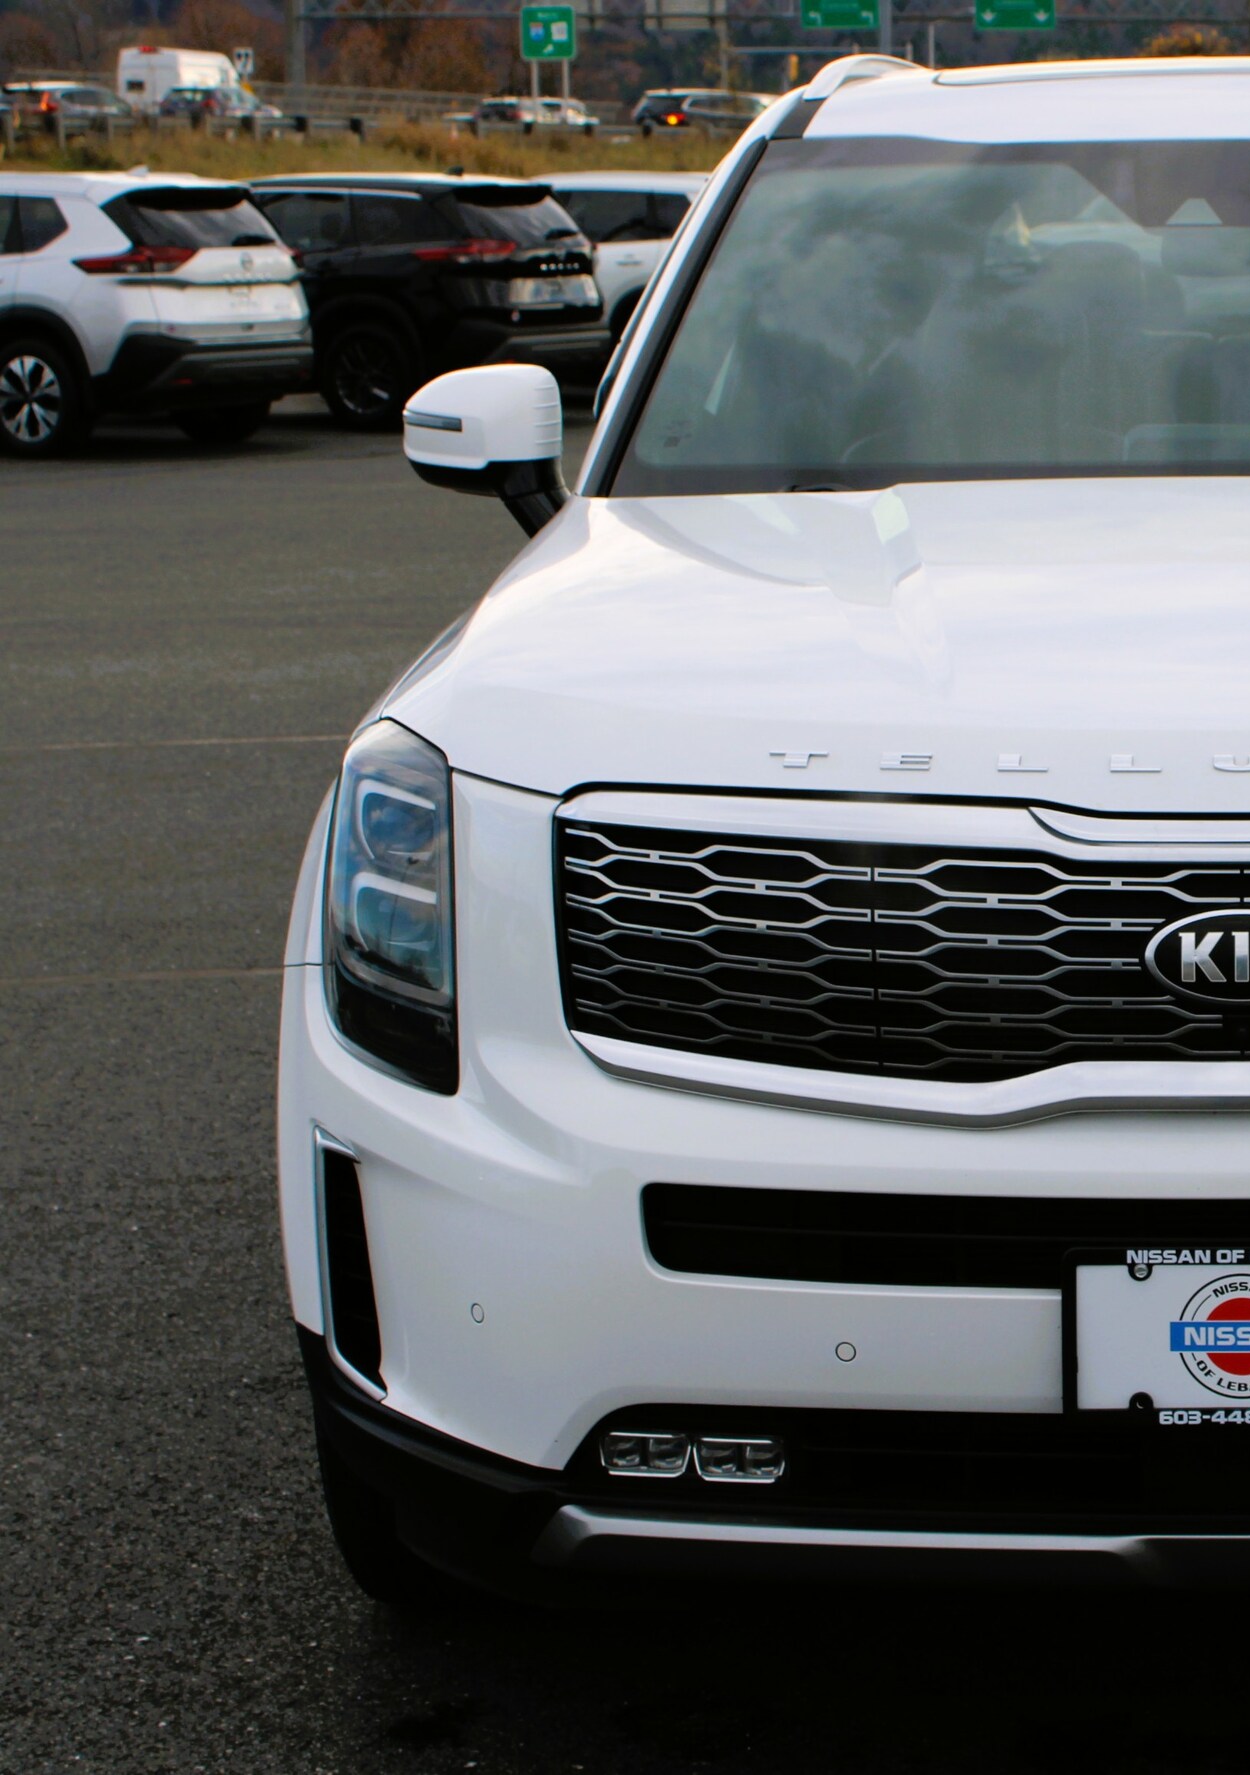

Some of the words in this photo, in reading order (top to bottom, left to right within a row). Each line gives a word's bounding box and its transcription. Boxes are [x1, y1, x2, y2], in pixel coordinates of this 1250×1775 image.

[1126, 1249, 1212, 1264] NISSAN
[1216, 1249, 1244, 1264] OF
[1195, 1359, 1214, 1379] OF
